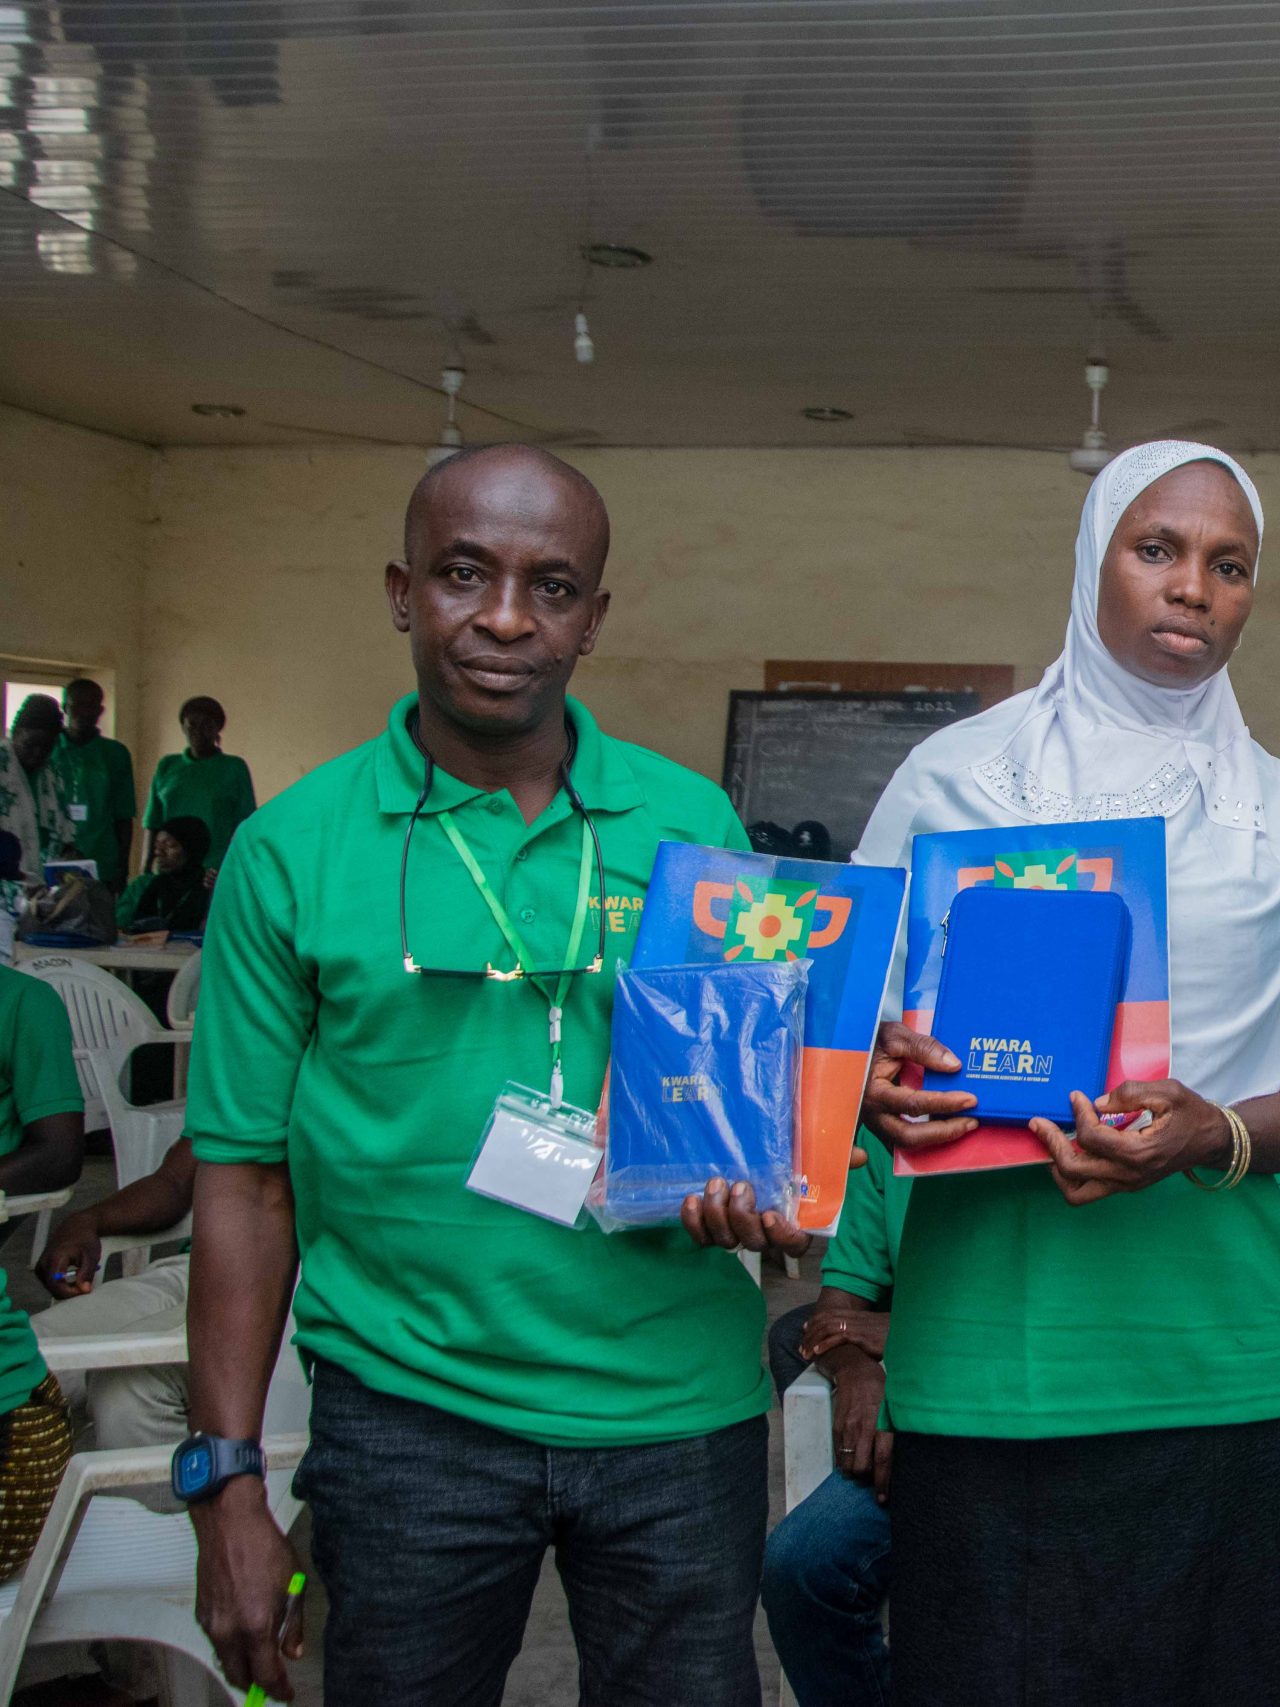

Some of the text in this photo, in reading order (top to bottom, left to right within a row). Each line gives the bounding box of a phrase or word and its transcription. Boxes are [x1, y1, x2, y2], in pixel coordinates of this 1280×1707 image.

[587, 895, 644, 911] KWAR
[970, 1037, 1032, 1053] KWARA
[967, 1051, 1054, 1075] LEARN
[662, 1074, 707, 1087] KWARA
